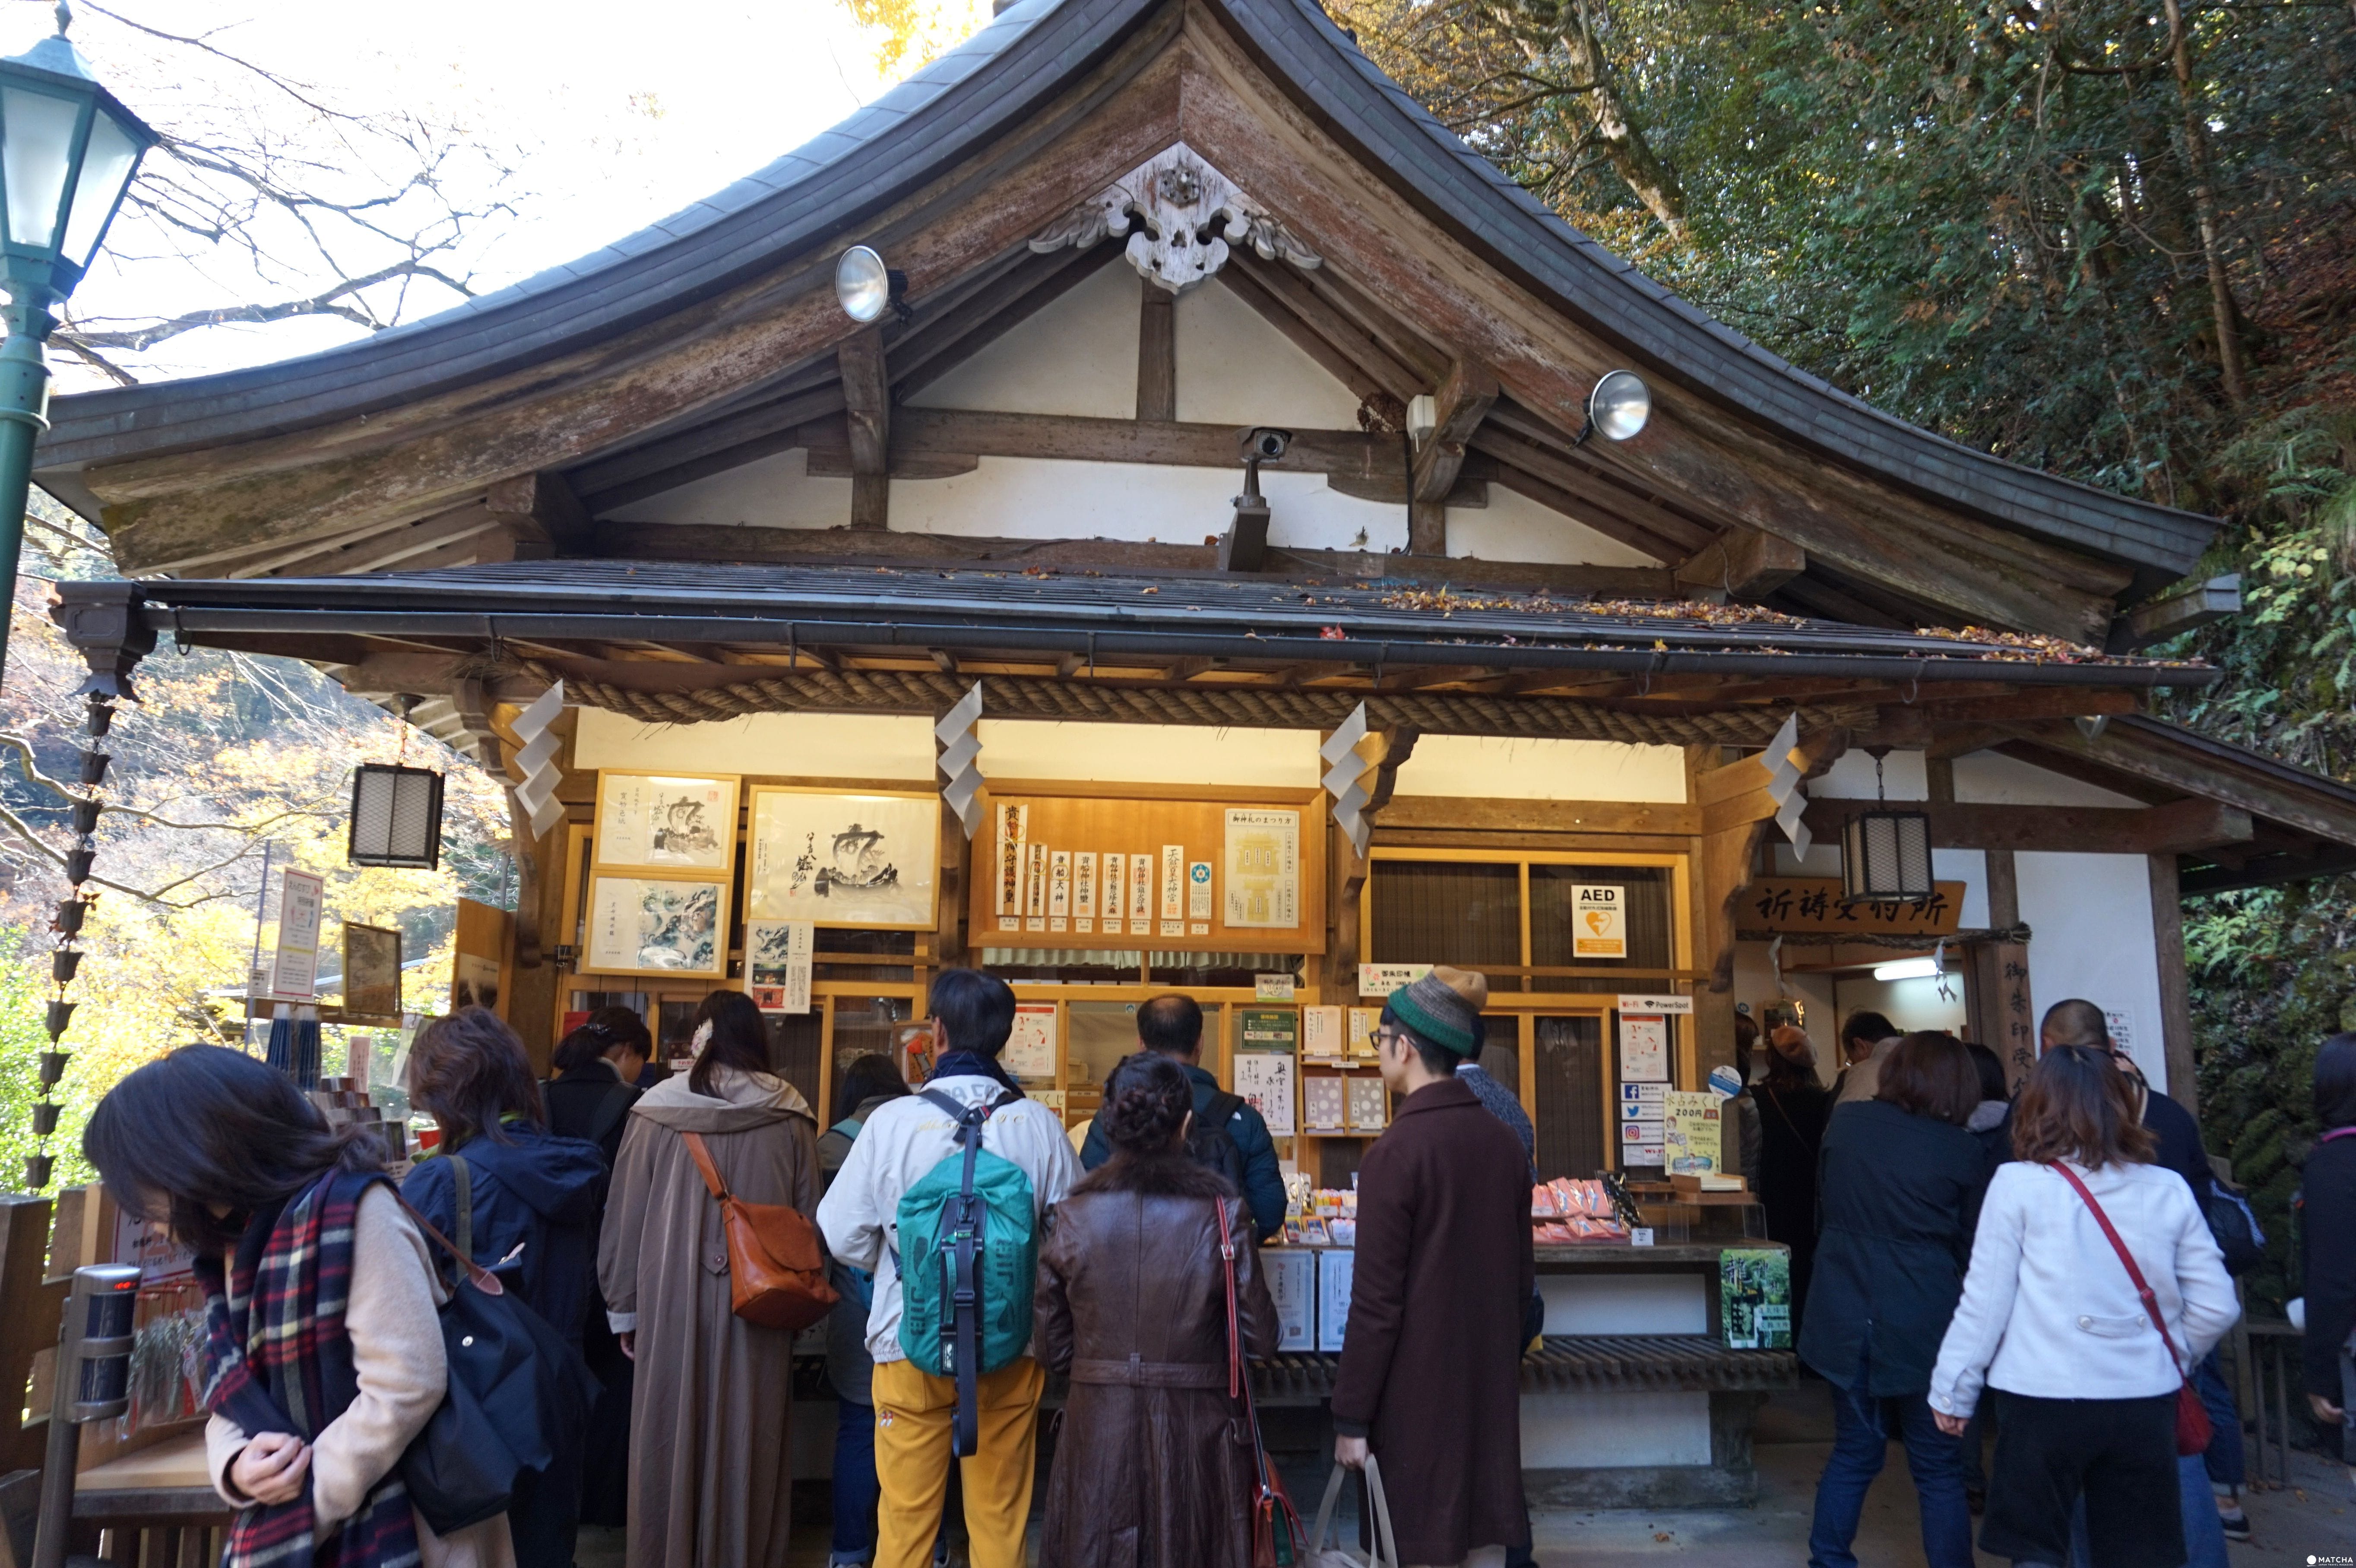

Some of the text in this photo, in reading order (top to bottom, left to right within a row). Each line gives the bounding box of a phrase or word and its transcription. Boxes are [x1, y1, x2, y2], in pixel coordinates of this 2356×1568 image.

[1580, 889, 1615, 901] AED
[1675, 1108, 1702, 1117] 200円
[910, 1286, 926, 1335] JIB
